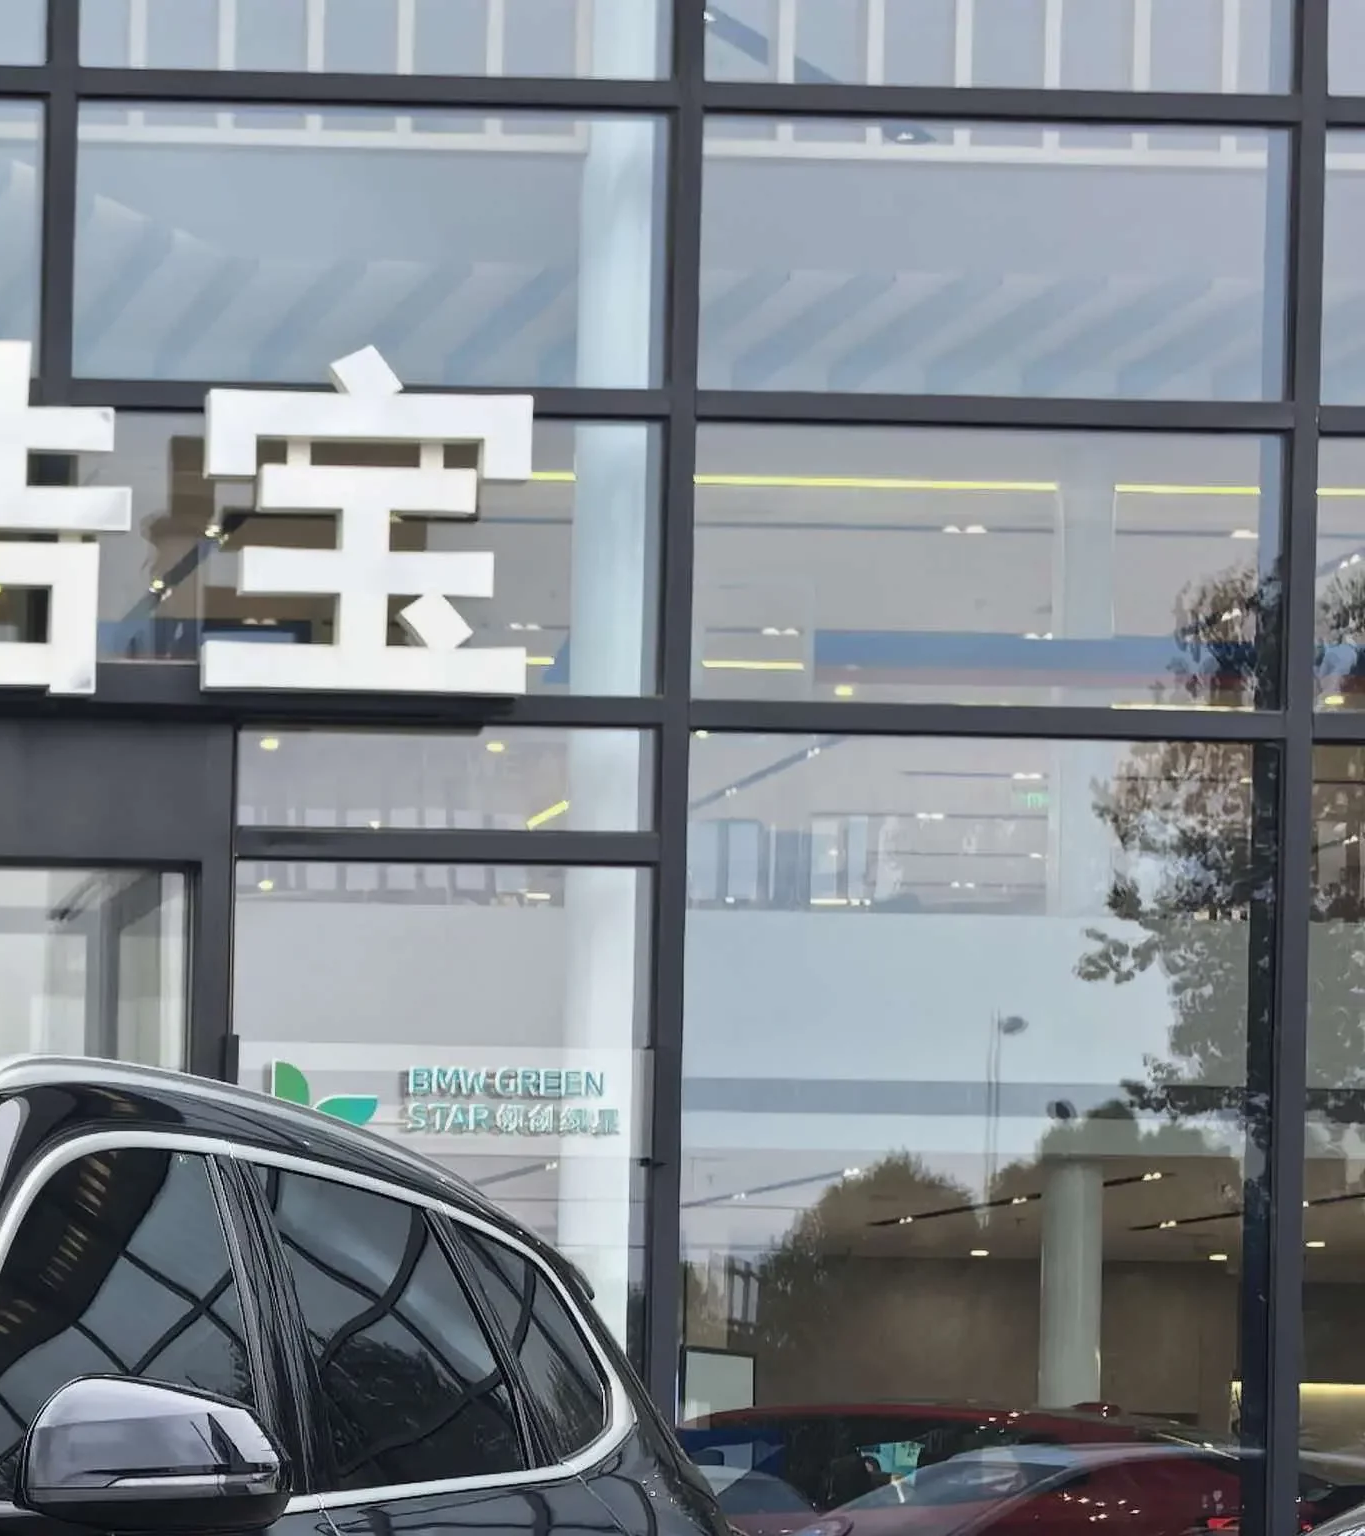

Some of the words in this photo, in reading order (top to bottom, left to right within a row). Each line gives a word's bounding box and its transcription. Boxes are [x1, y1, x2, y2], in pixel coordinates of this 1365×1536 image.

[408, 1066, 488, 1097] BMW
[494, 1068, 605, 1098] GREEN
[408, 1103, 490, 1132] STAR
